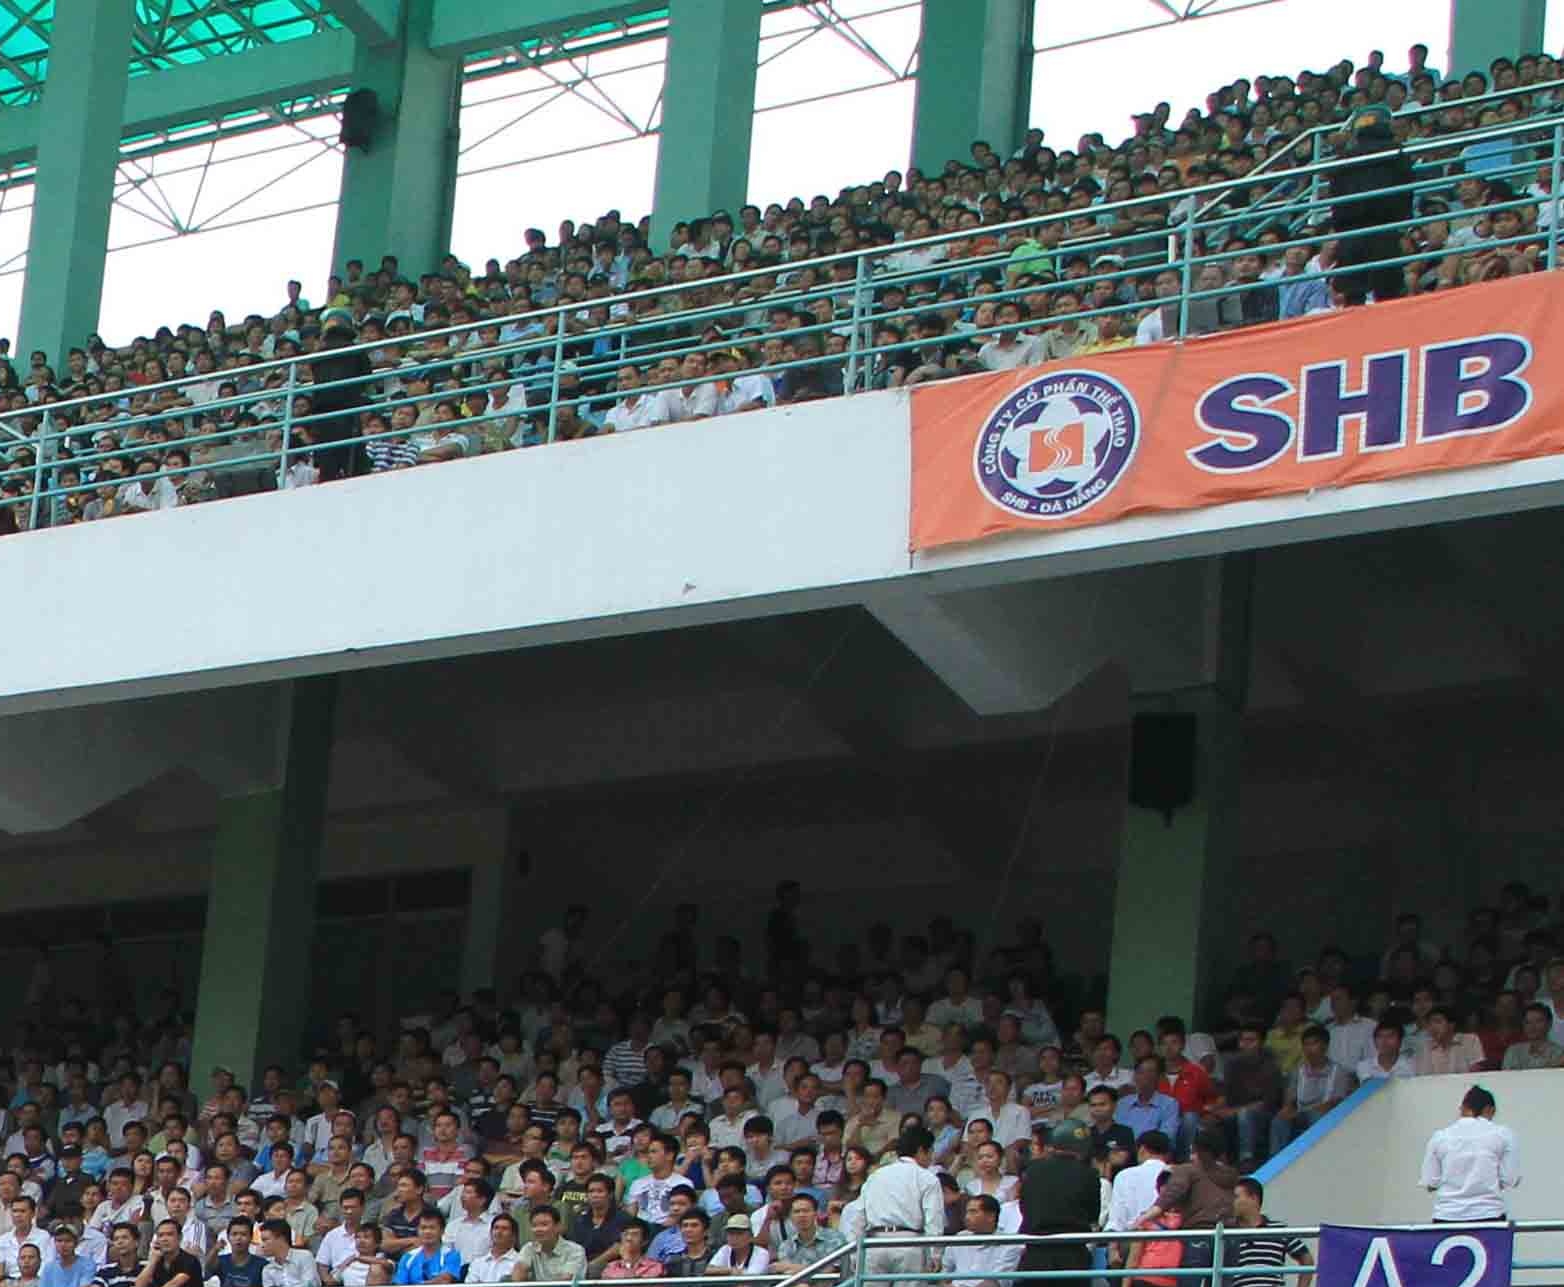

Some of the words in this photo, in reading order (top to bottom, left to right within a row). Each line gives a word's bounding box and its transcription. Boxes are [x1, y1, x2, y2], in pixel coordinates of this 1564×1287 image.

[1184, 333, 1533, 474] SHB
[995, 408, 1014, 431] TY
[1111, 406, 1128, 448] THAO
[1000, 491, 1029, 510] SHB
